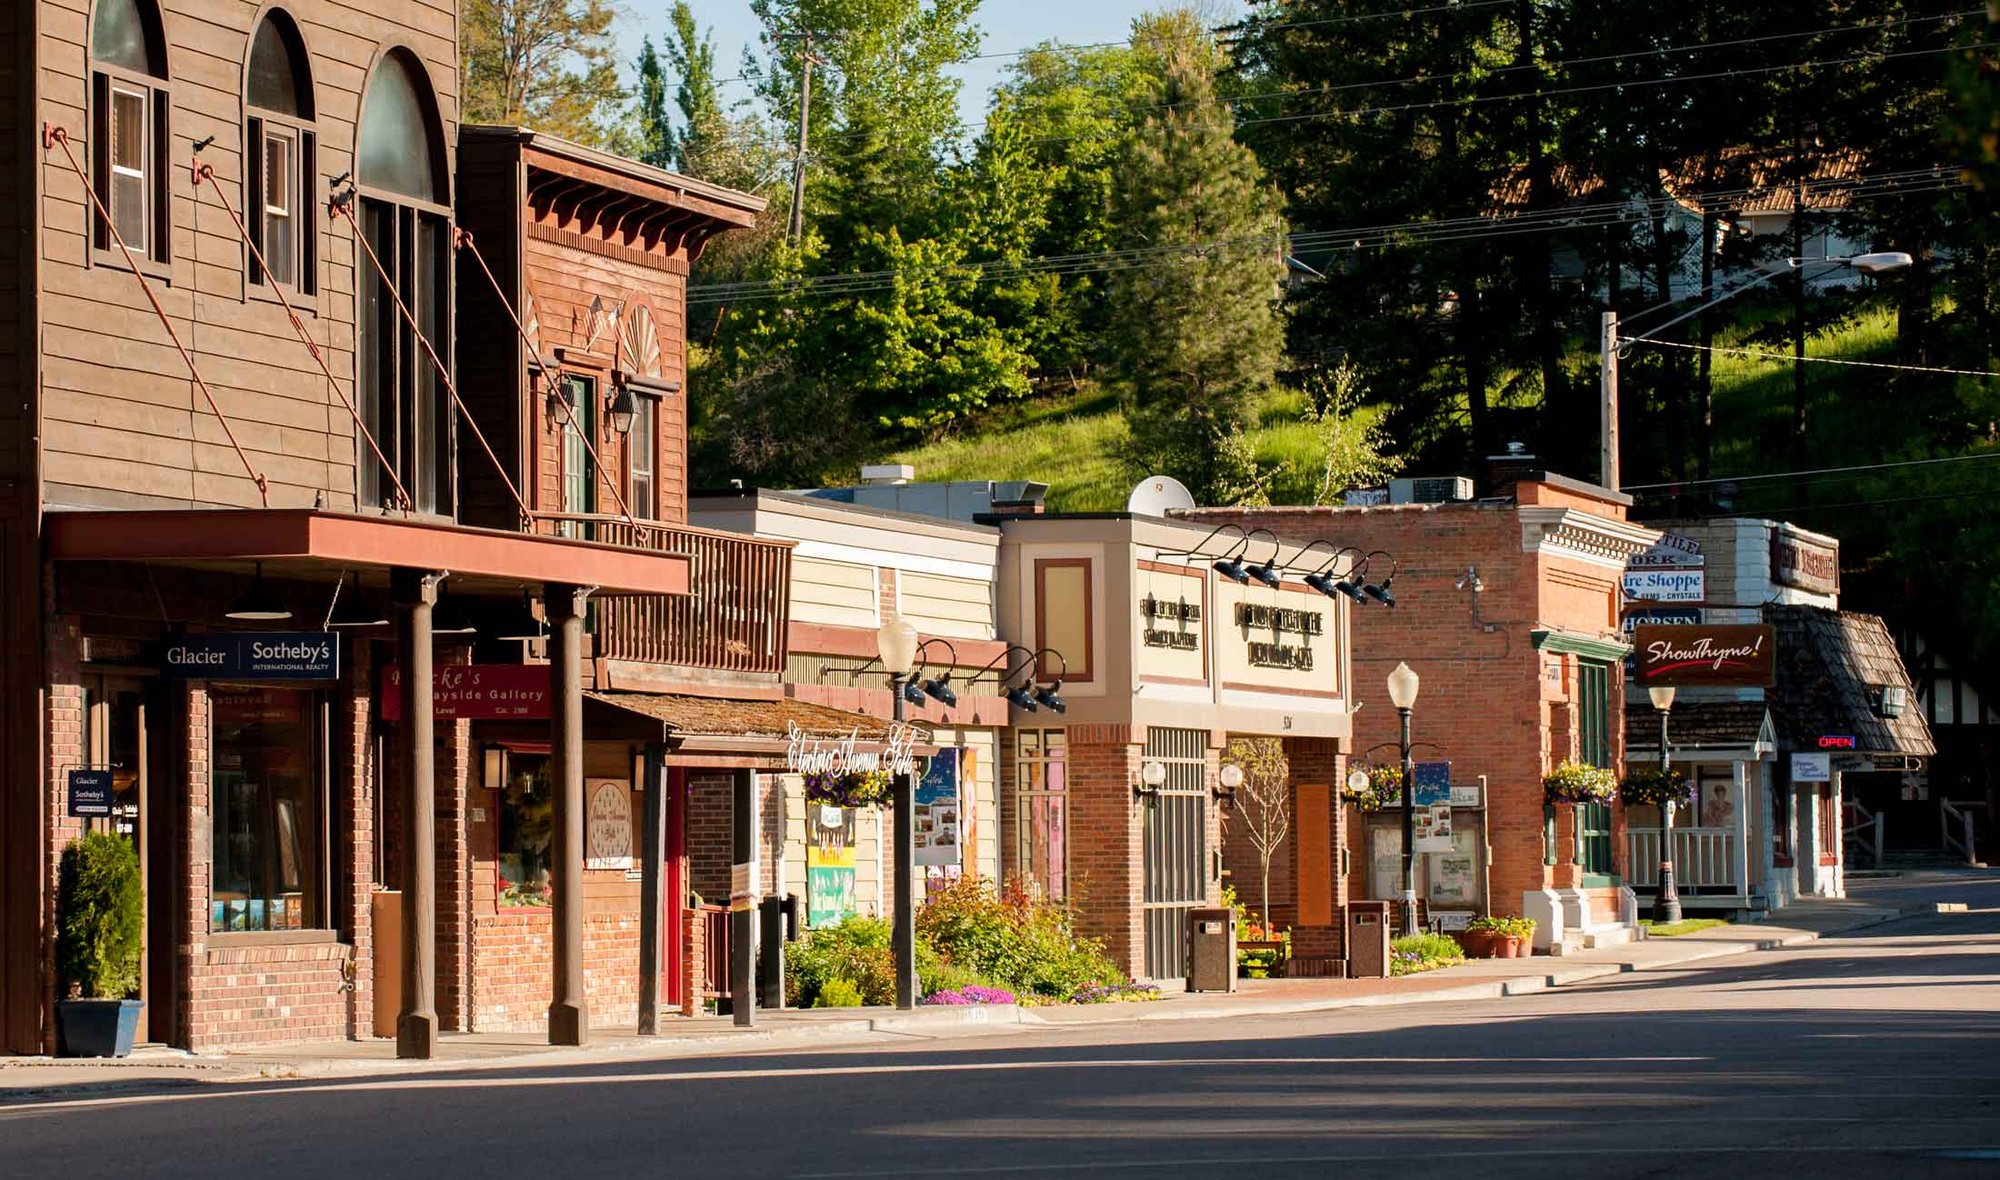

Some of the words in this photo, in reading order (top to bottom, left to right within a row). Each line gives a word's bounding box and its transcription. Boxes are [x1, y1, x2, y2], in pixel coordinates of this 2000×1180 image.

[1646, 572, 1701, 591] Shoppe
[166, 646, 227, 665] Glacier
[252, 641, 330, 664] Sotheby's
[433, 690, 482, 701] ayside
[489, 690, 543, 701] Gallery
[1818, 737, 1853, 748] OPEN
[831, 727, 879, 778] Avenue
[75, 790, 104, 799] Sotheby's
